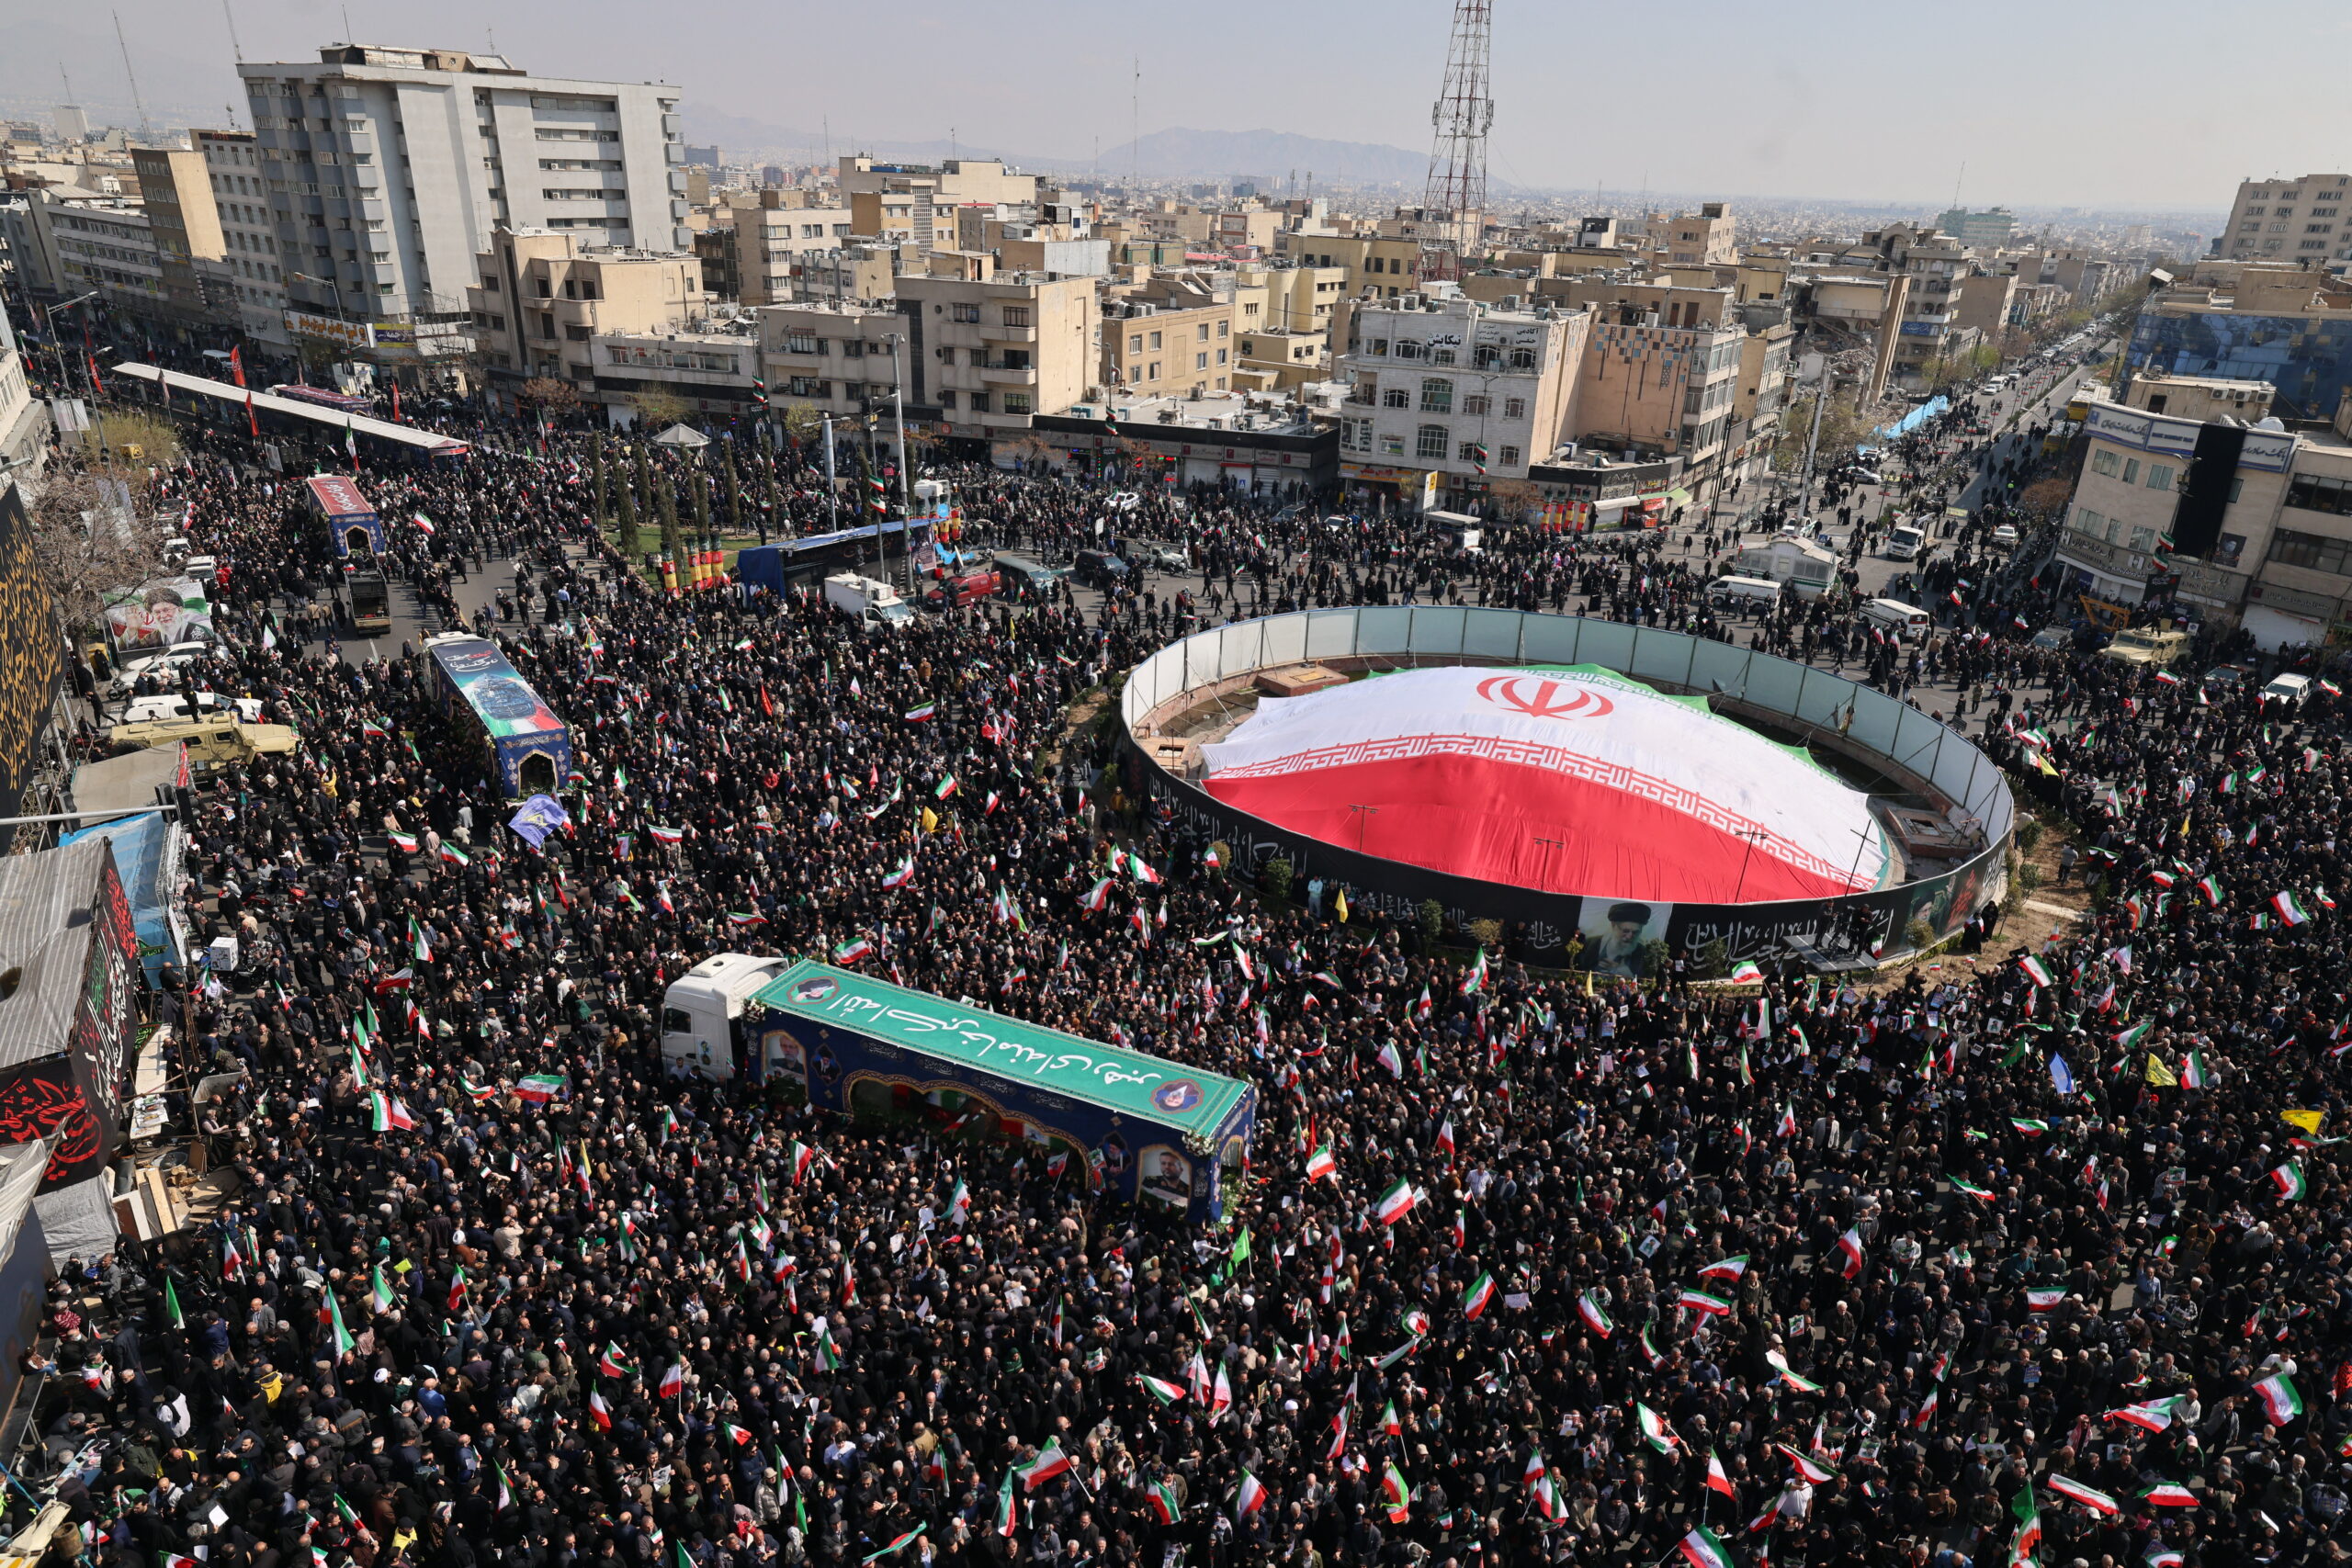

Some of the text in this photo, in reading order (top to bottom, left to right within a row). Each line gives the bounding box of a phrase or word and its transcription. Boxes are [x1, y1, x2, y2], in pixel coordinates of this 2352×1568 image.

[826, 992, 882, 1017] الله
[867, 1004, 980, 1032] اکبر
[1092, 1062, 1163, 1086] رهبر
